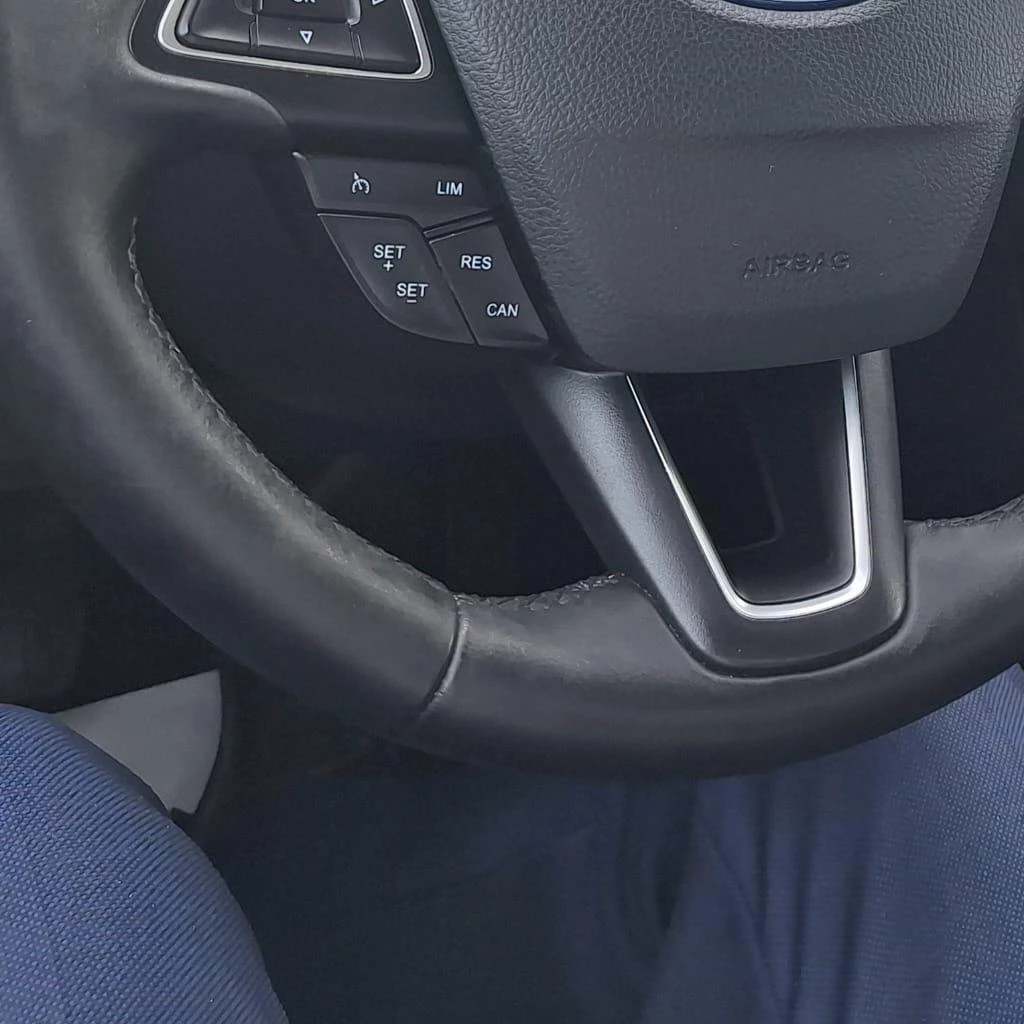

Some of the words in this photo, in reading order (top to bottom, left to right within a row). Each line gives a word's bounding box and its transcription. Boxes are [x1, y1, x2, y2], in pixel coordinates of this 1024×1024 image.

[437, 181, 463, 196] LIM
[373, 245, 406, 260] SET
[461, 255, 492, 270] RES
[396, 283, 429, 298] SET
[486, 303, 519, 317] CAN
